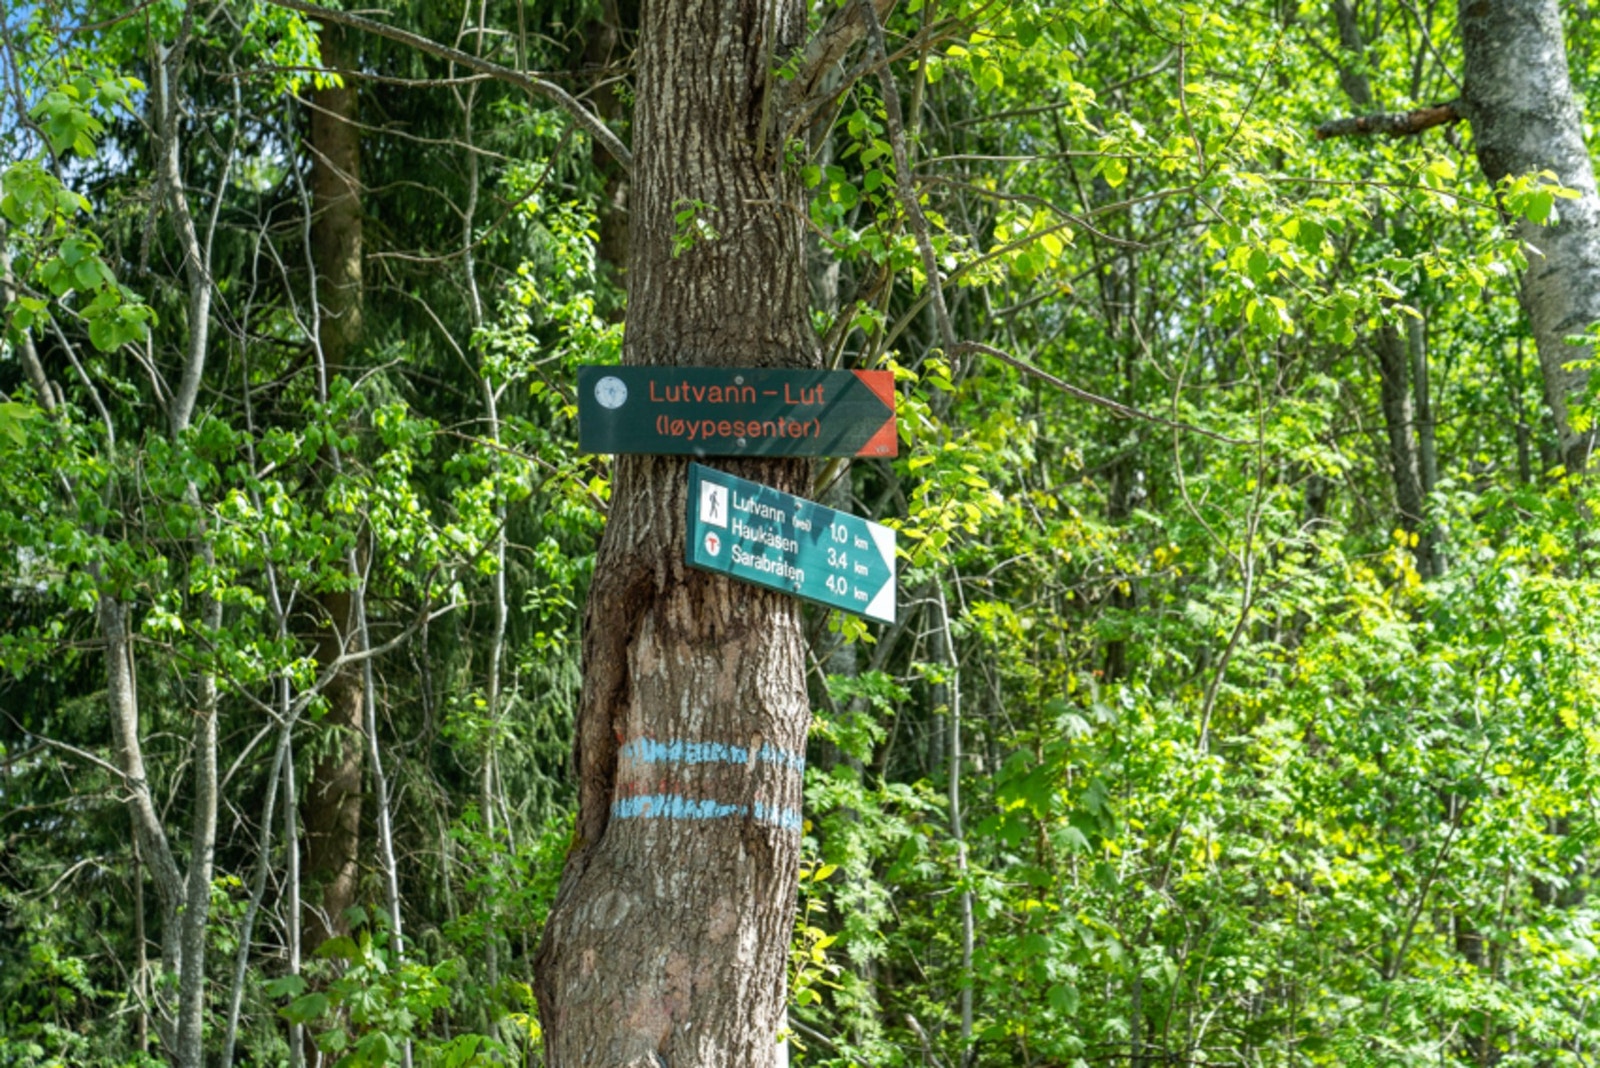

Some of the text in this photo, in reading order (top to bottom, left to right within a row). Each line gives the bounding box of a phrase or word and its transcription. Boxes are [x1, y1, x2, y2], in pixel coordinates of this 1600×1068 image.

[649, 380, 756, 404] Lutvann
[784, 383, 825, 405] Lut
[656, 415, 821, 440] (løypesenter)
[732, 517, 868, 576] Haukåsen 3,4 km
[733, 490, 785, 523] Lutvann
[854, 534, 868, 551] km
[731, 544, 868, 602] Sarabråten 4,0 km
